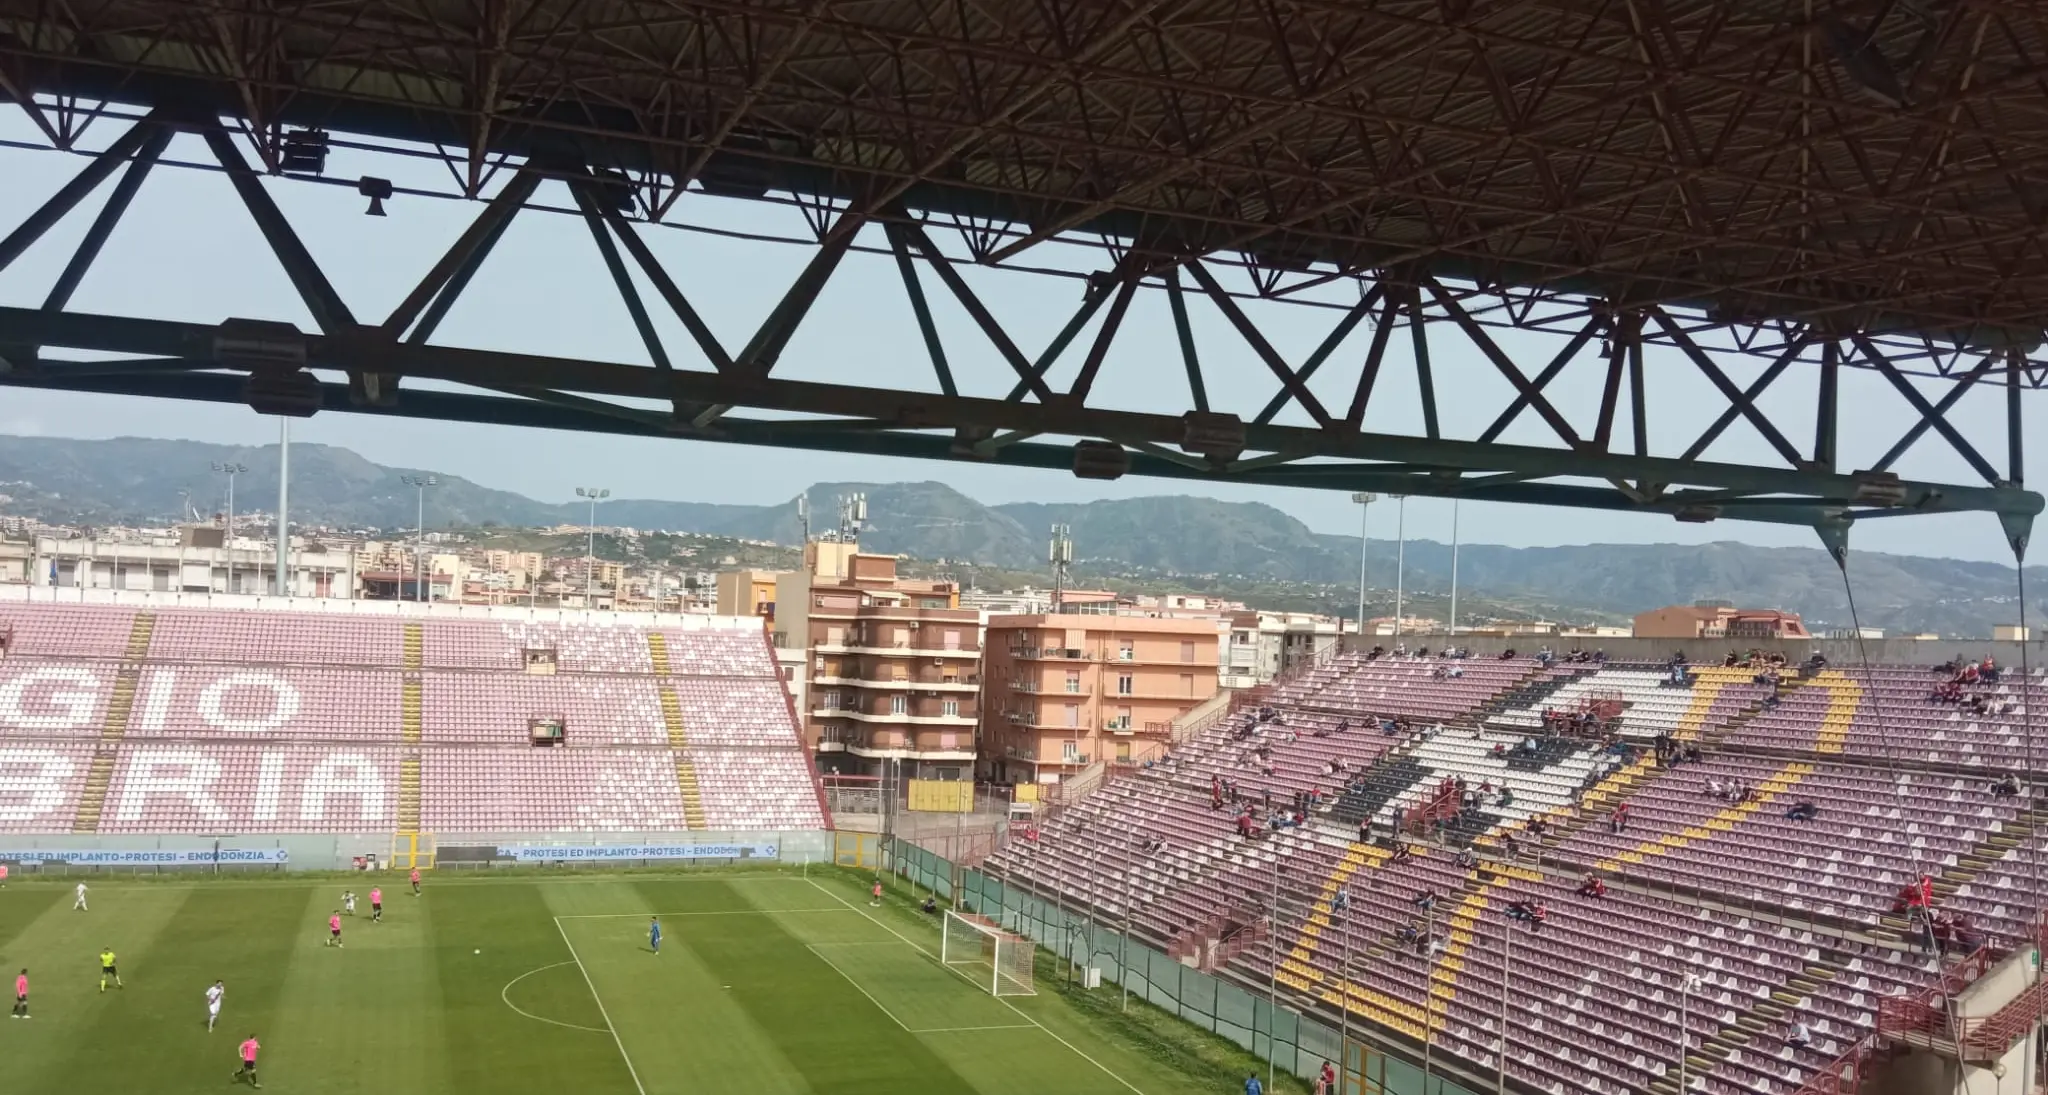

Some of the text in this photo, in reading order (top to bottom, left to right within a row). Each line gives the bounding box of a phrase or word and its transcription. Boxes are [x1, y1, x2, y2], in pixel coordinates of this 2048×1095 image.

[0, 666, 300, 732] GIO
[37, 852, 54, 861] ED
[56, 851, 177, 862] IMPLANTO-PROTESI
[523, 848, 568, 858] PROTESI
[570, 848, 584, 857] ED
[585, 846, 685, 858] IMPLANTO-PROTESI
